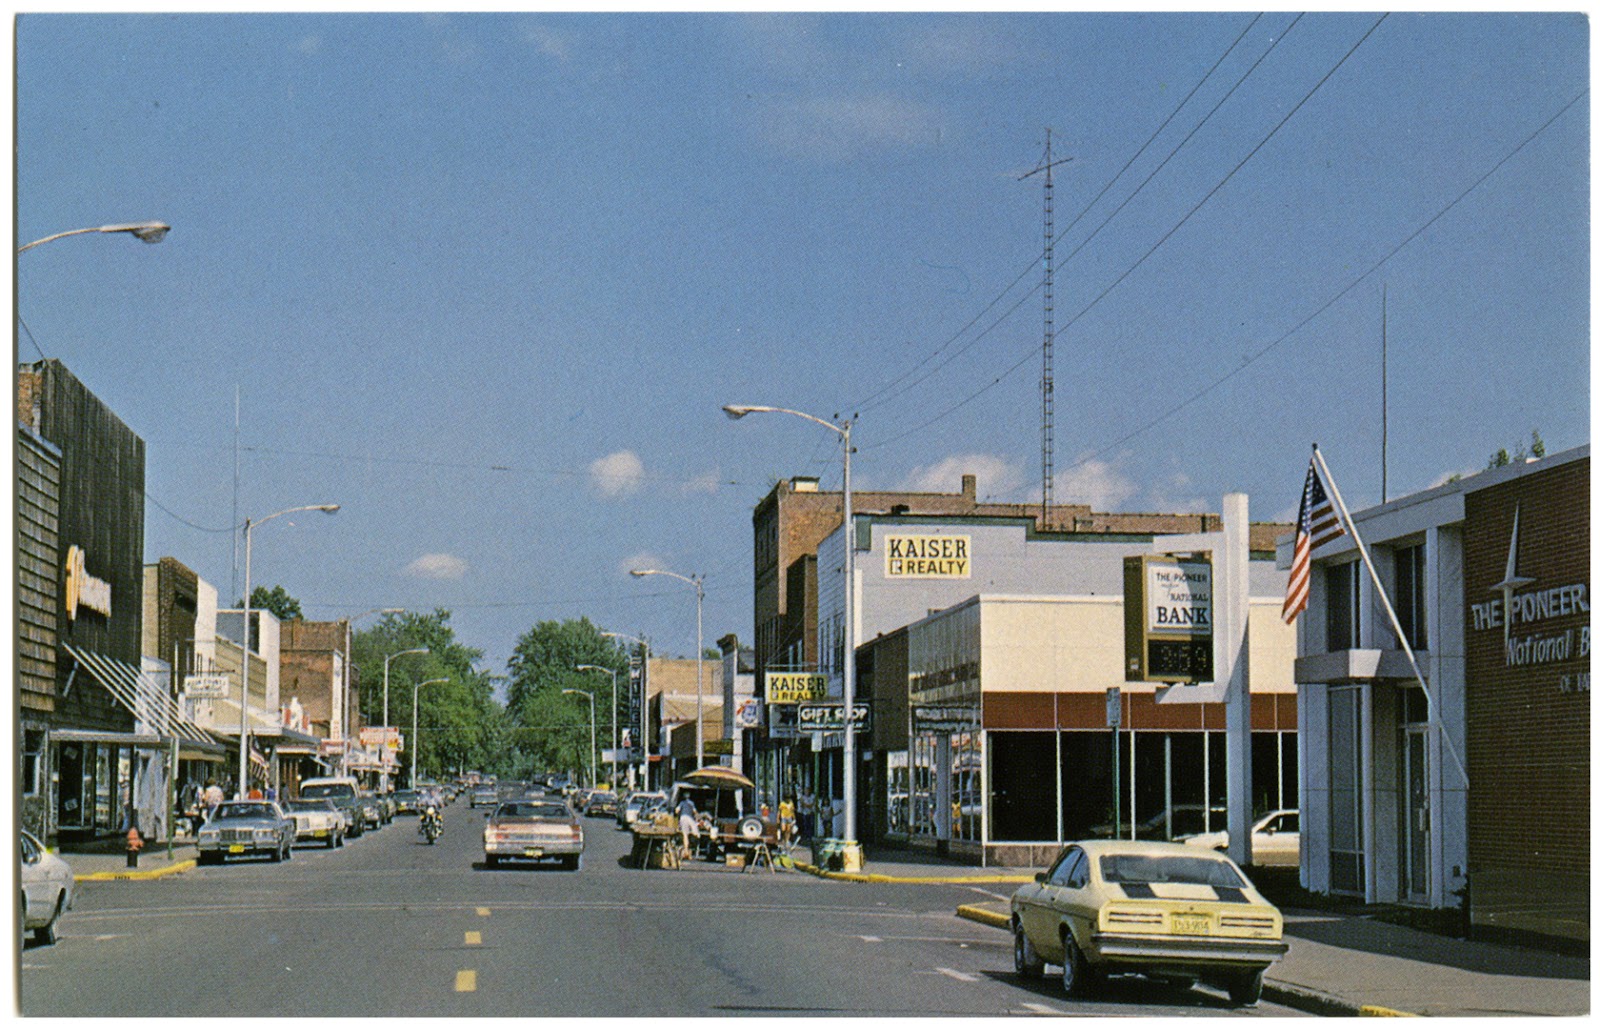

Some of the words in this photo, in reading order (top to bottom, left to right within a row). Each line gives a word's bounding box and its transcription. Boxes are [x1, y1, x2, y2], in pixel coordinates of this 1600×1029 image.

[889, 539, 967, 558] KAISER
[907, 560, 966, 575] REALTY
[1156, 572, 1170, 581] THE
[1174, 573, 1208, 582] PIONEER
[1170, 592, 1209, 602] NATIONAL
[1472, 600, 1503, 630] THE
[1511, 583, 1590, 624] PIONEER
[1156, 606, 1209, 624] BANK
[1506, 630, 1570, 666] National
[770, 677, 826, 691] KAISER
[782, 691, 826, 701] REALTY
[801, 708, 831, 723] GIFT
